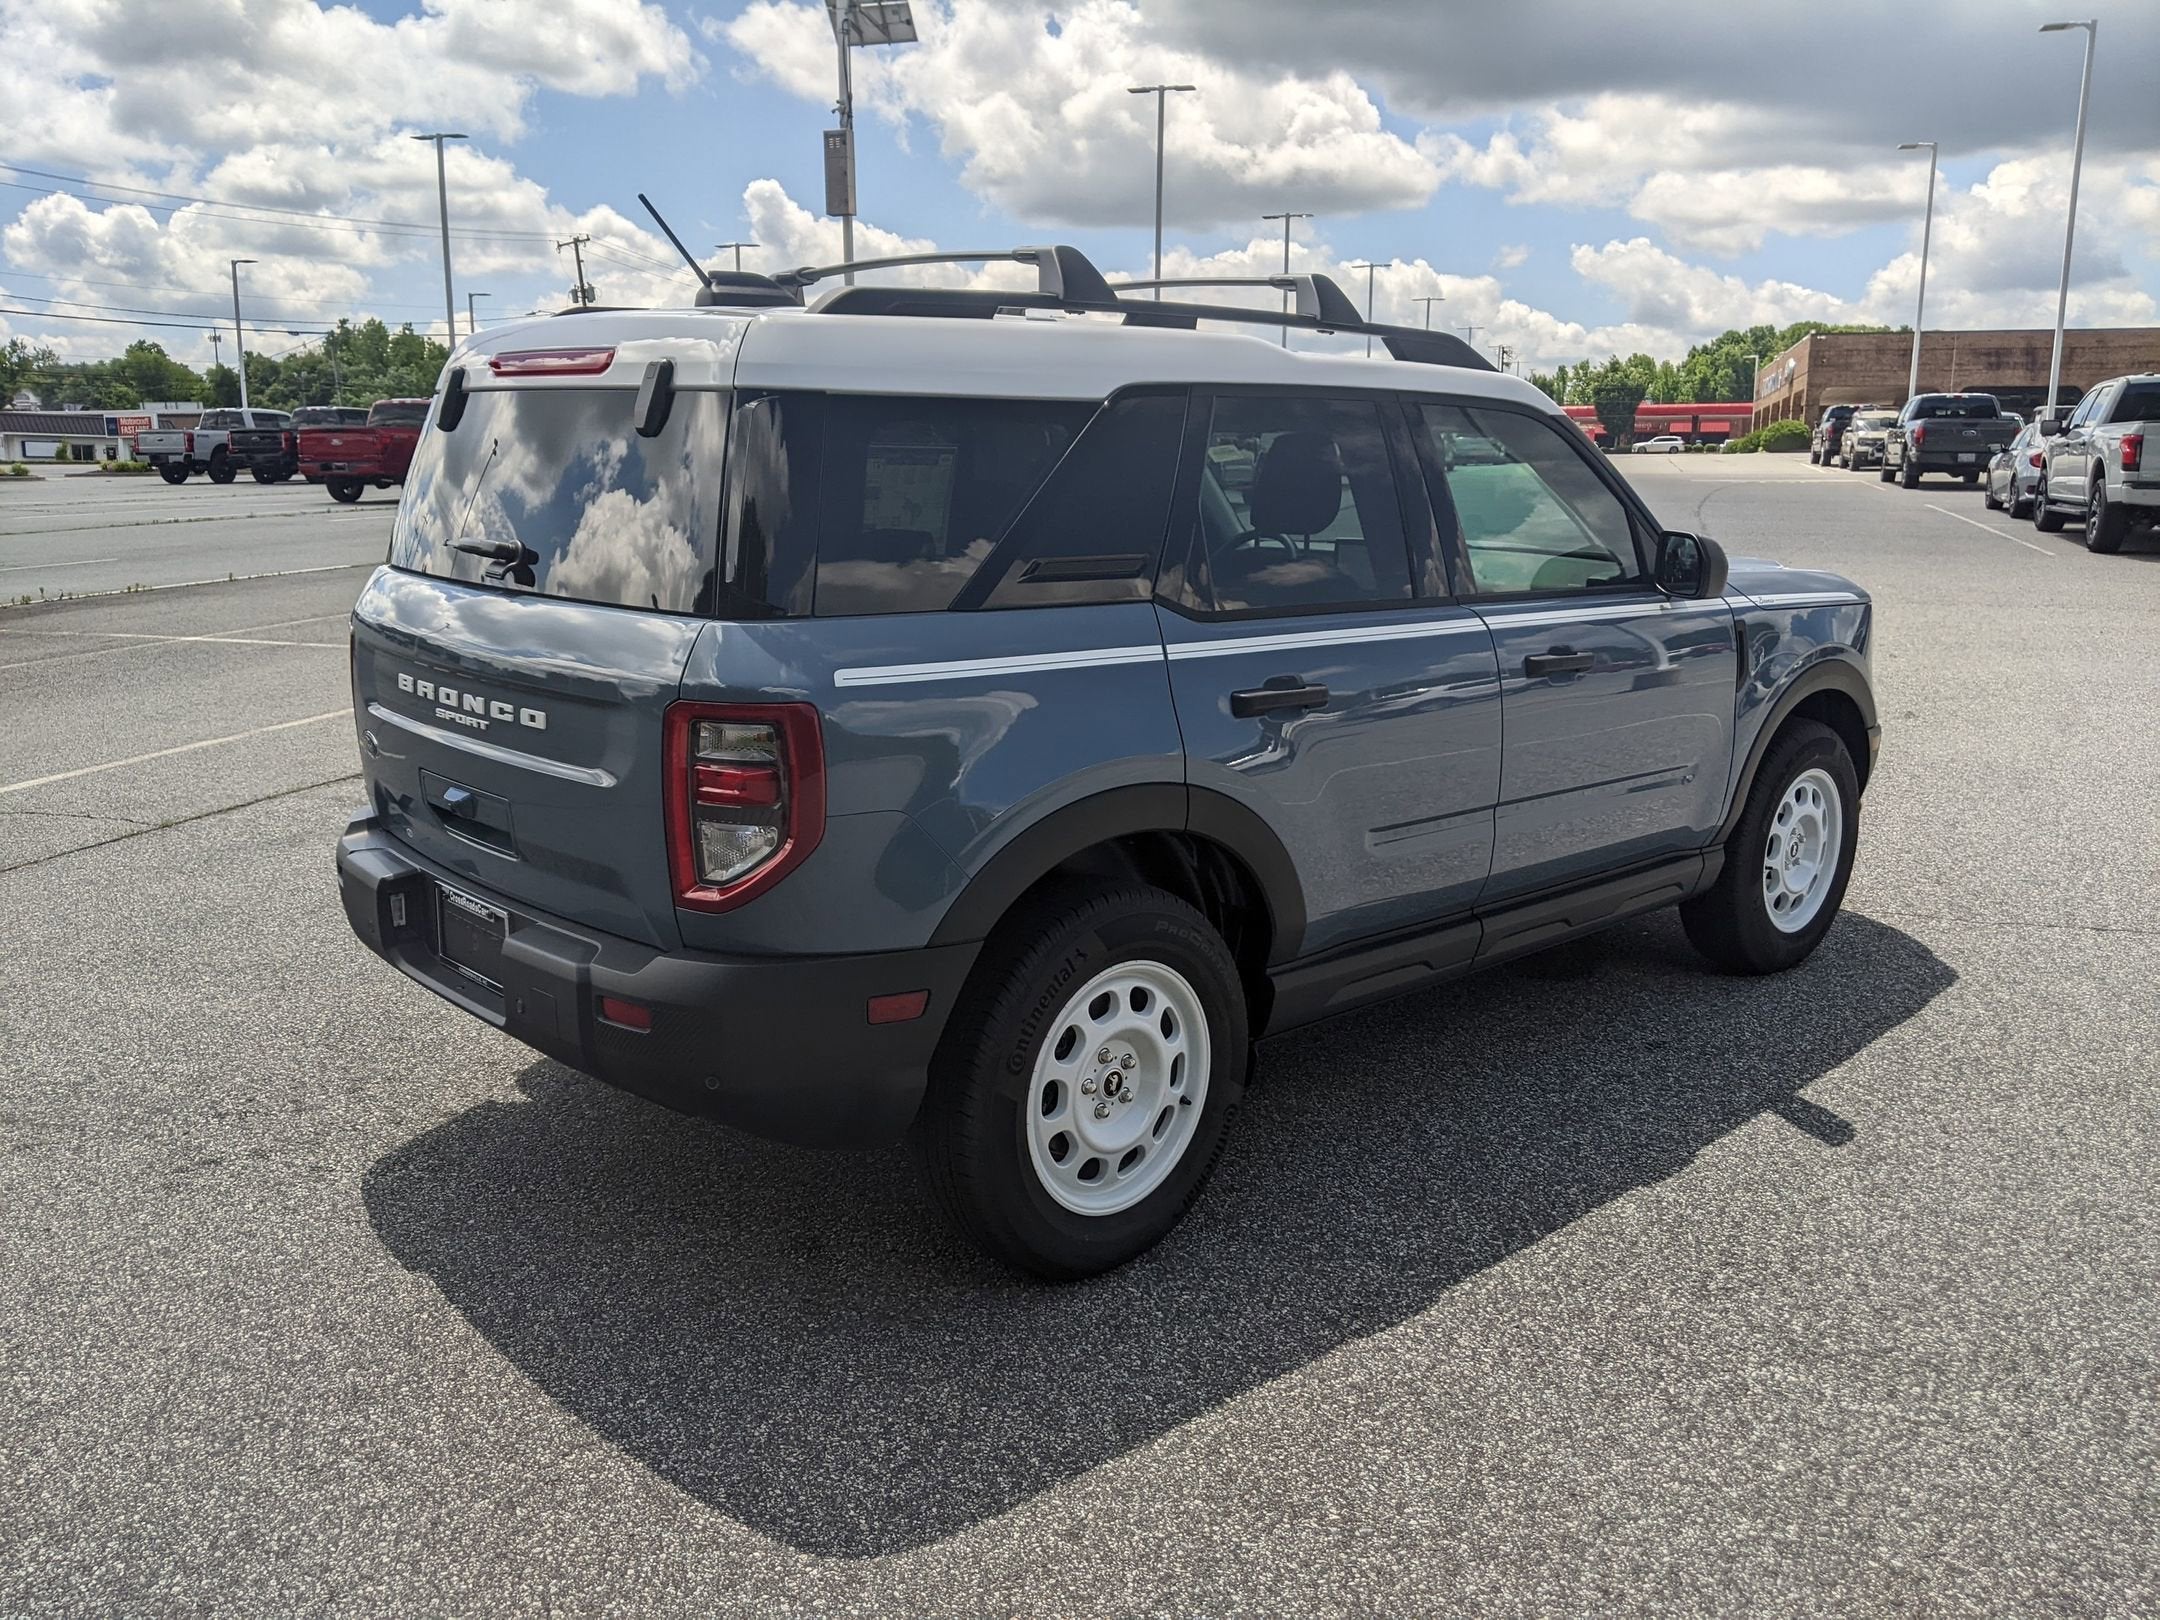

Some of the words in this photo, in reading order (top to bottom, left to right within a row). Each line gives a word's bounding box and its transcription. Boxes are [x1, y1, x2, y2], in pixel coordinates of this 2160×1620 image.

[121, 425, 135, 434] FAST
[397, 672, 547, 730] BRONCO
[435, 707, 490, 730] SPORT
[1006, 956, 1078, 1075] Continental
